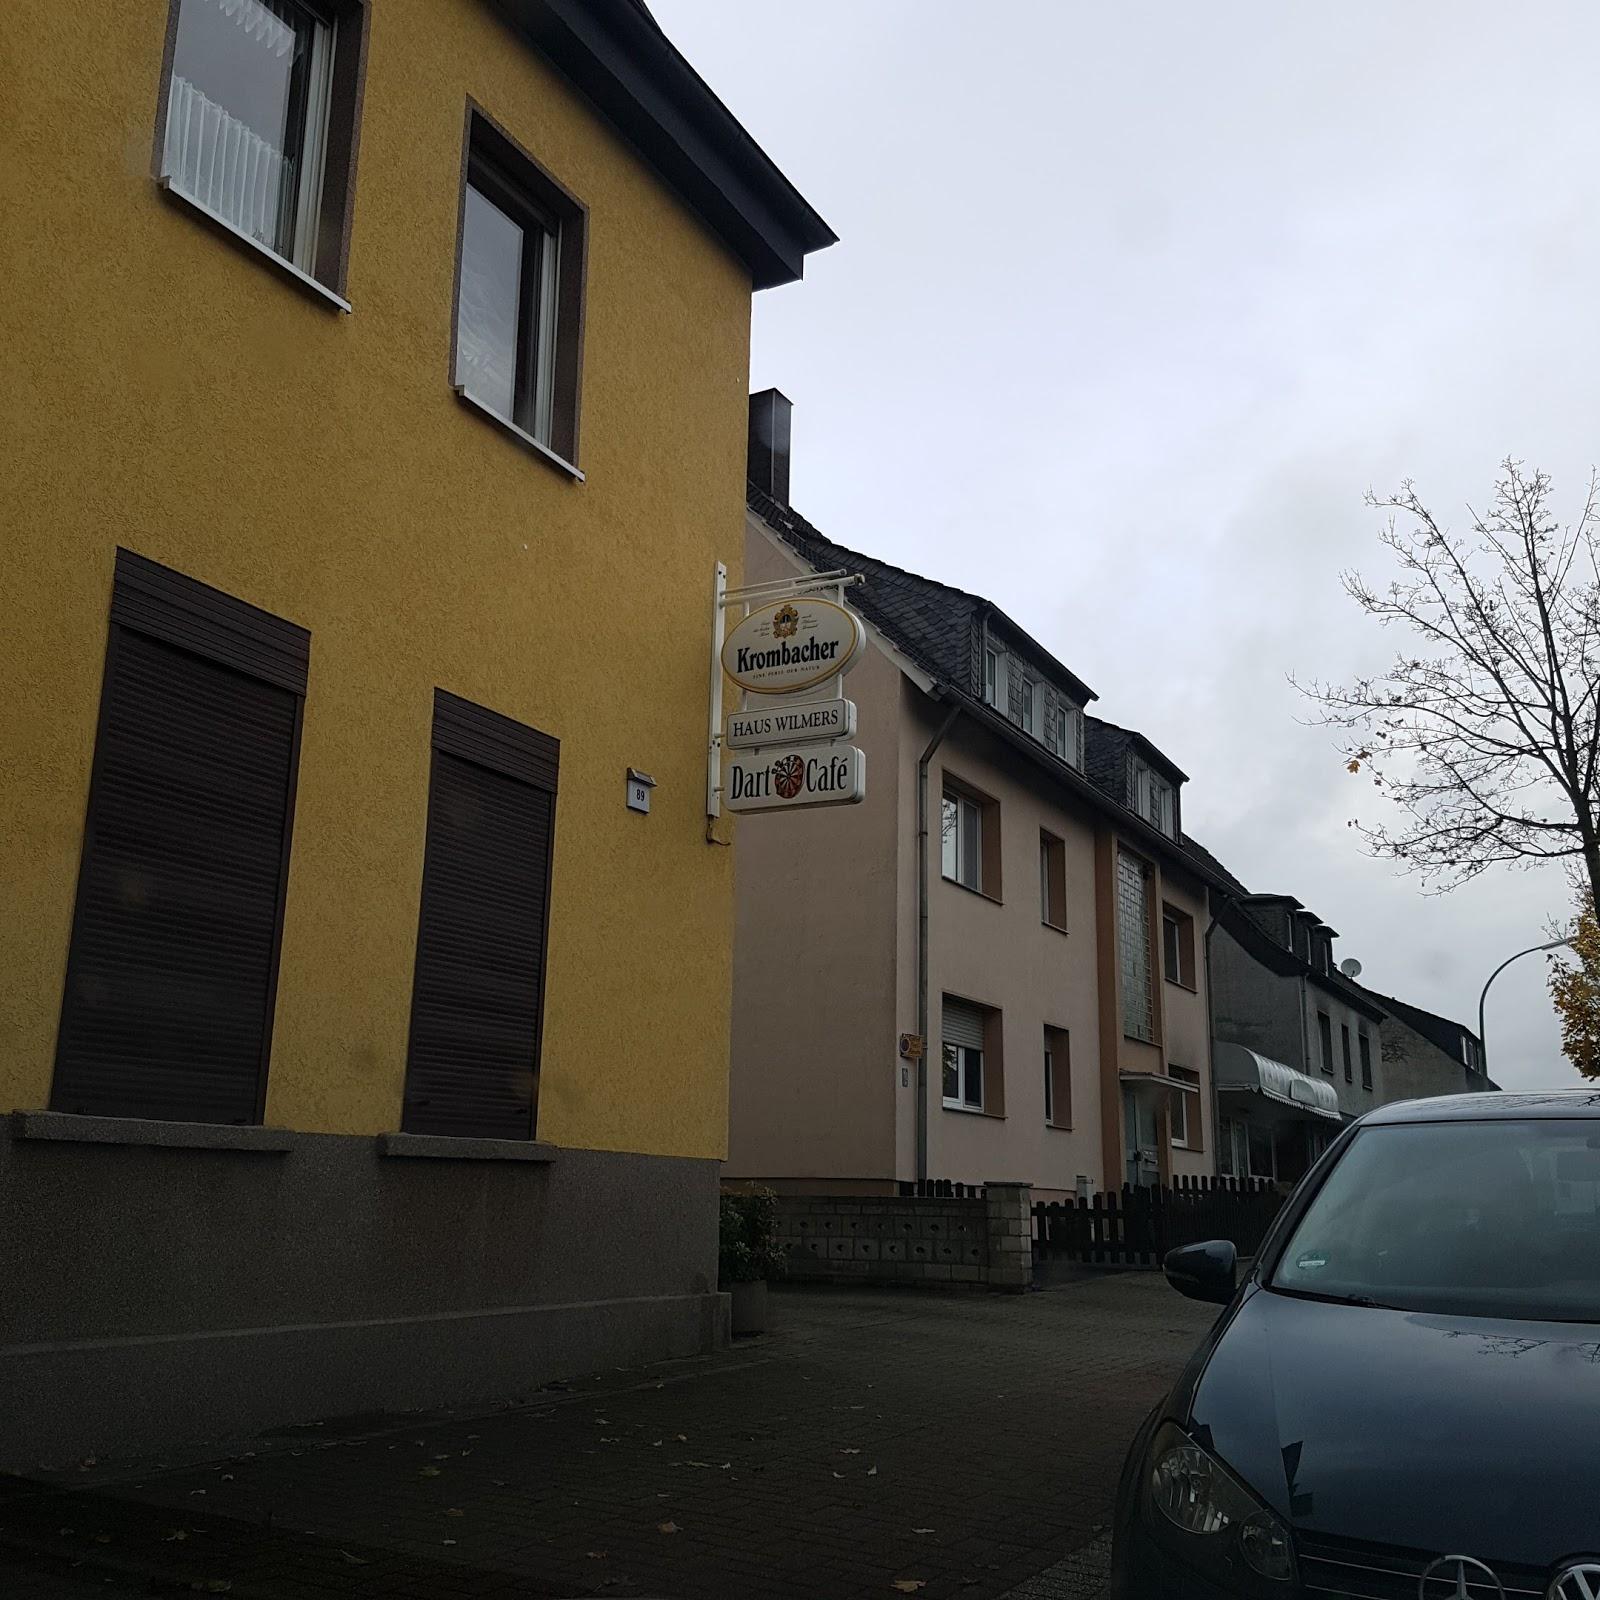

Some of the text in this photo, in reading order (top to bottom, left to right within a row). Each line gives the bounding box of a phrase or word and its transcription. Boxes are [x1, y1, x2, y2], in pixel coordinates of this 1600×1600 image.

[737, 636, 839, 673] Krombacher
[733, 709, 838, 737] HAUS WILMERS
[731, 757, 848, 800] Dart Café
[636, 788, 645, 802] 89
